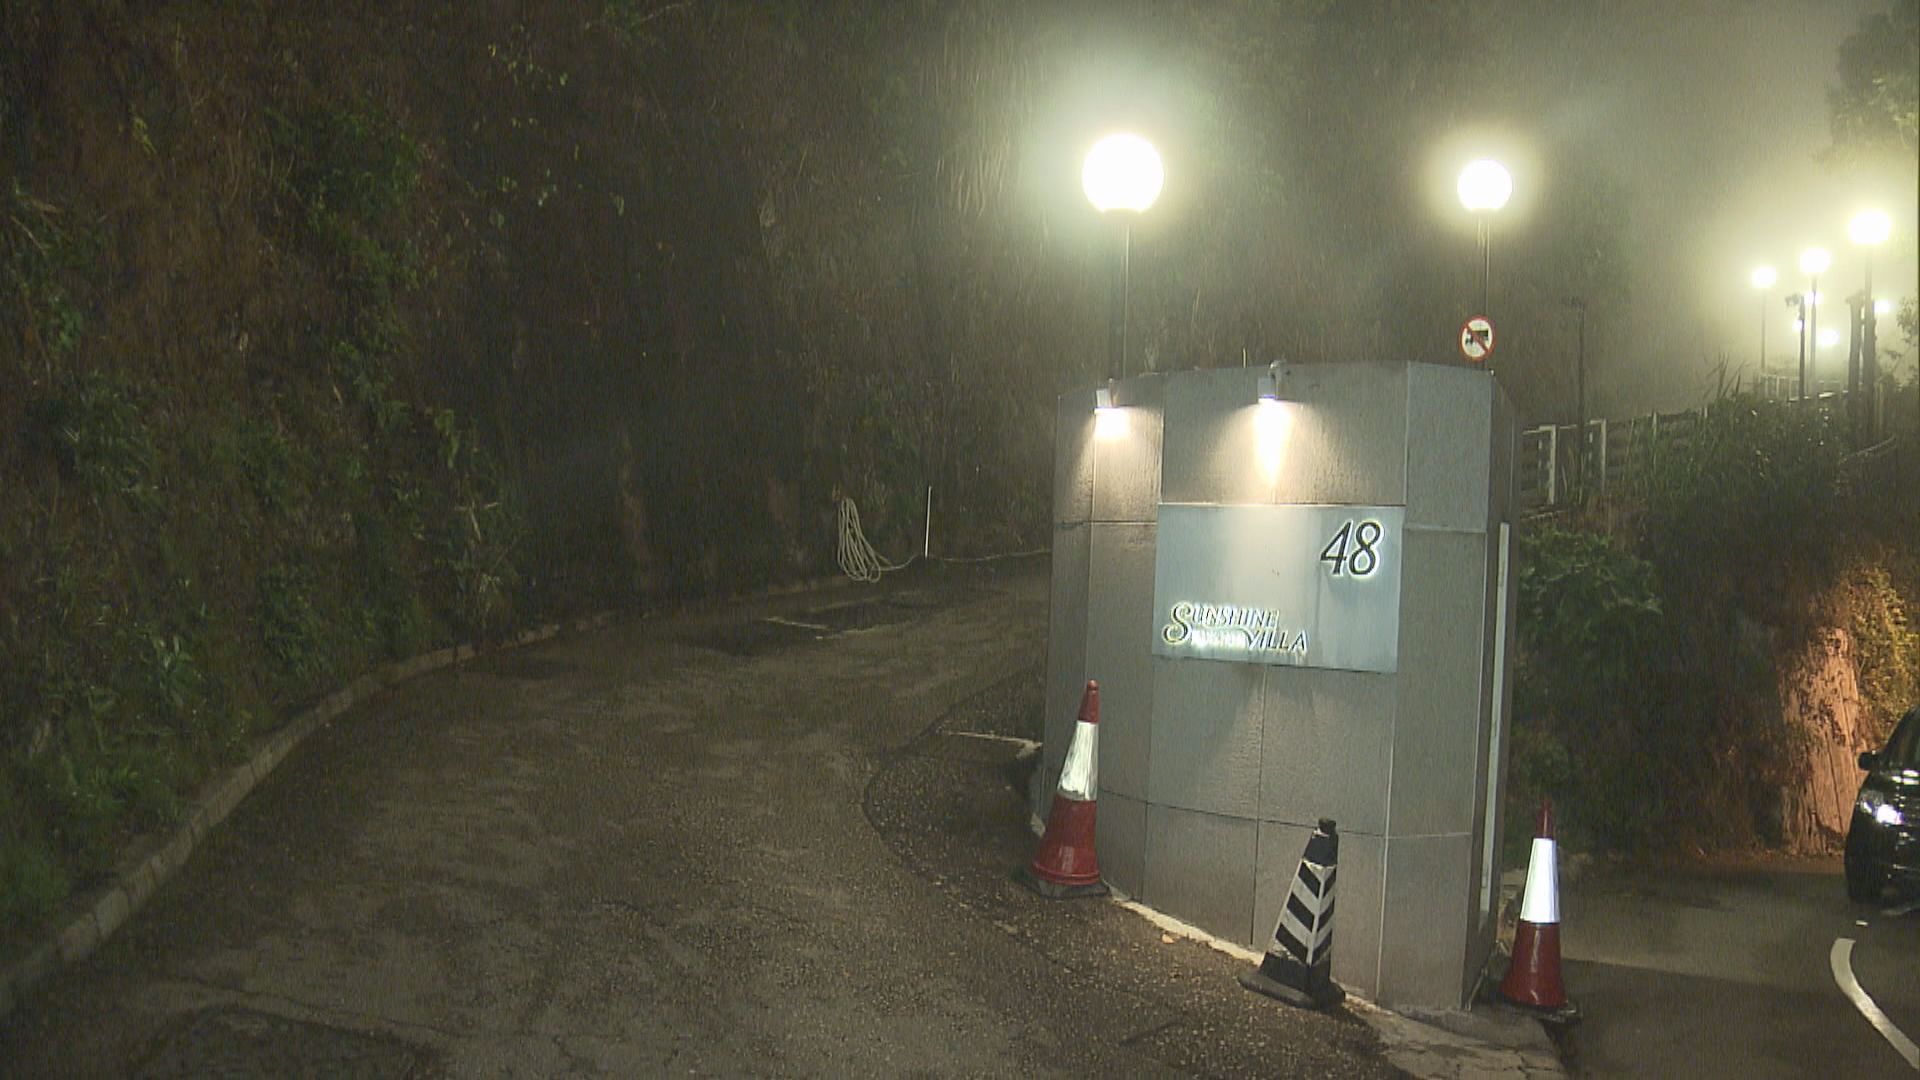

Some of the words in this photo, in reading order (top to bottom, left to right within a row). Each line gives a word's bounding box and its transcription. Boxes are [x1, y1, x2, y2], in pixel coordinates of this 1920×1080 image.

[1320, 521, 1382, 576] 48
[1162, 602, 1279, 644] SUNSHINE
[1245, 630, 1307, 651] VILLA
